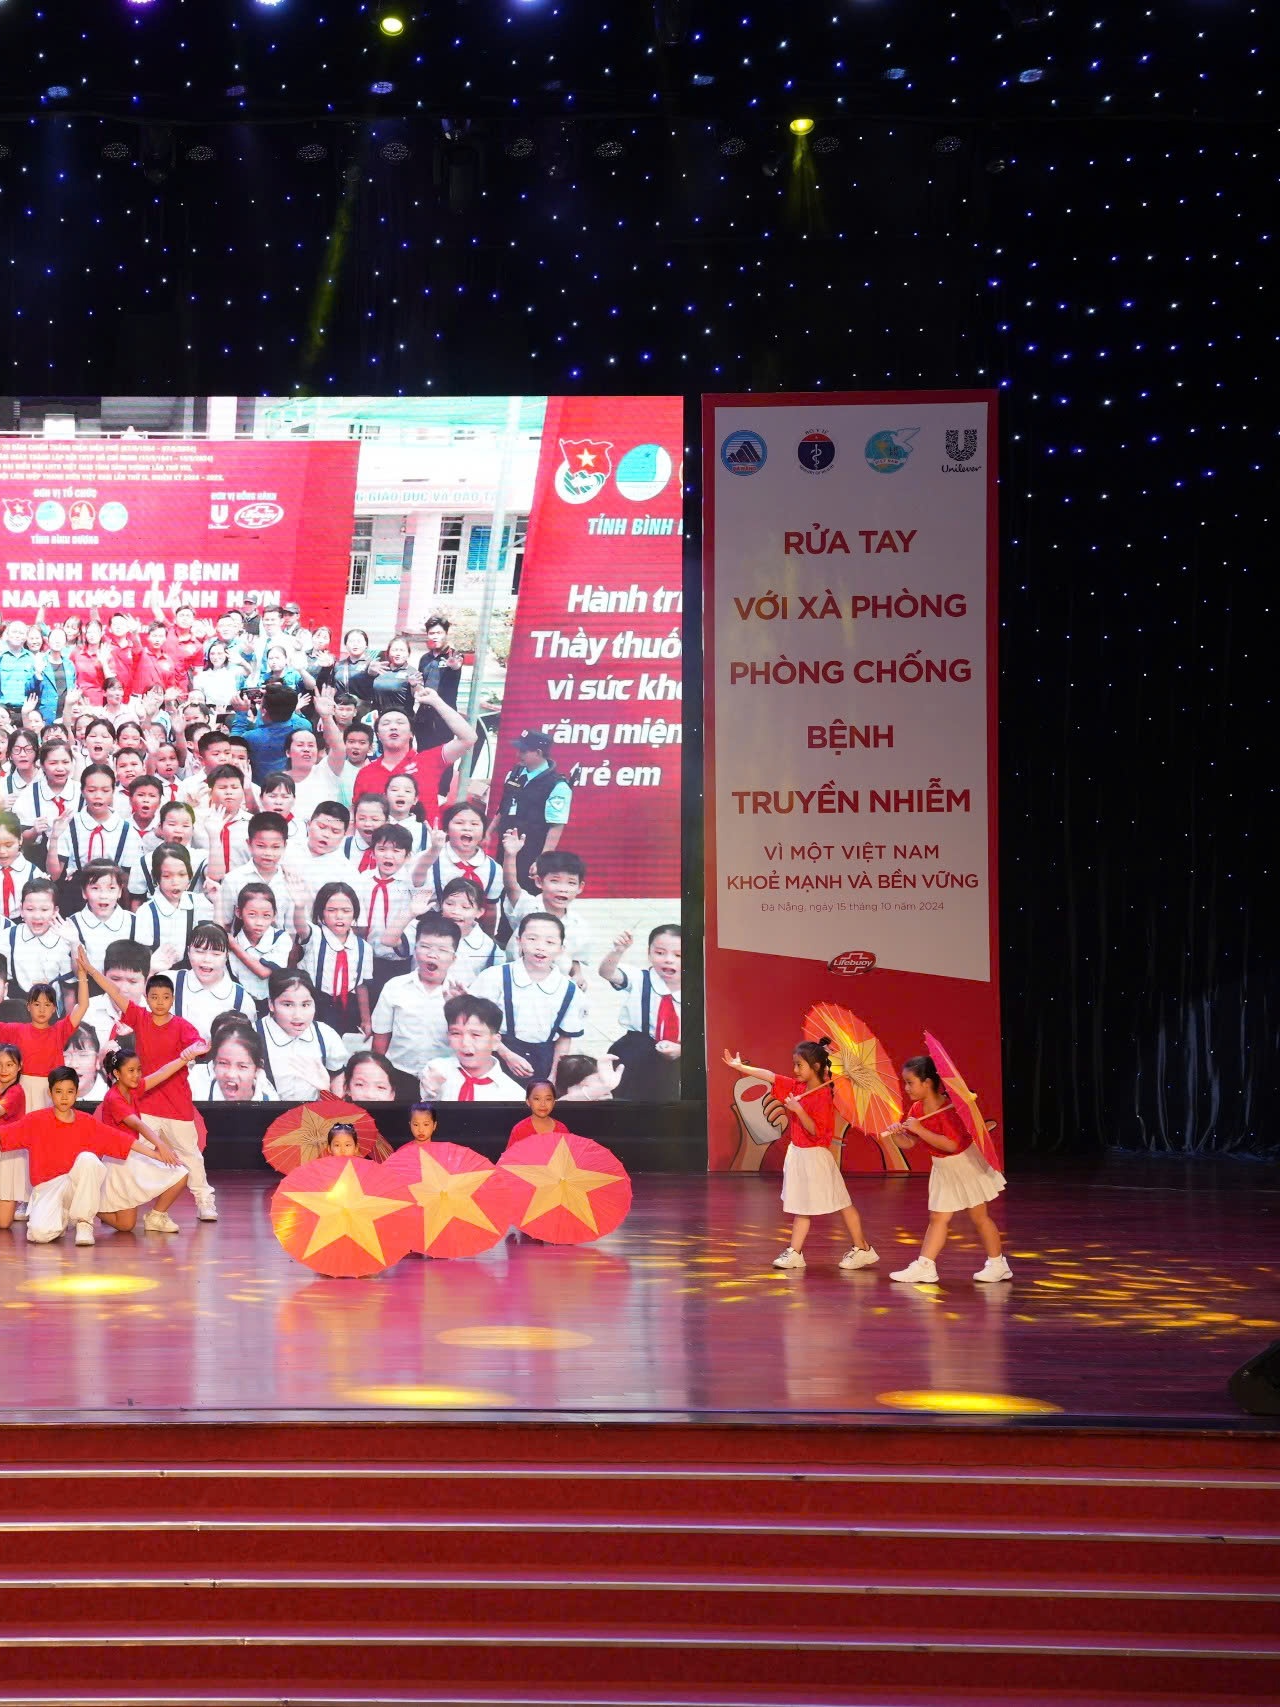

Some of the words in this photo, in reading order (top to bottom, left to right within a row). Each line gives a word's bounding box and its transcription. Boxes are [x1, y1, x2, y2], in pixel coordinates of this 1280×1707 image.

[941, 464, 982, 473] Unilever
[588, 513, 628, 536] TỈNH
[631, 514, 674, 536] BÌNH
[784, 523, 851, 555] RỬA
[859, 530, 918, 554] TAY
[6, 559, 83, 581] TRÌNH
[91, 559, 166, 581] KHÁM
[173, 559, 239, 586] BỆNH
[2, 589, 61, 609] NAM
[68, 585, 136, 609] KHỎE
[568, 584, 649, 613] Hành
[733, 590, 788, 621] VỚI
[798, 590, 842, 620] XÀ
[851, 588, 968, 619] PHÒNG
[531, 627, 609, 666] Thầy
[730, 654, 845, 685] PHÒNG
[853, 650, 972, 684] CHỐNG
[547, 674, 575, 701] vì
[578, 675, 634, 701] sức
[542, 719, 610, 751] răng
[807, 719, 894, 756] BỆNH
[616, 766, 661, 787] em
[732, 780, 860, 815] TRUYỀN
[870, 778, 971, 813] NHIỄM
[764, 843, 783, 861] VÌ
[791, 842, 835, 864] MỘT
[842, 842, 887, 863] VIỆT
[894, 845, 940, 860] NAM
[727, 870, 780, 890] KHOẺ
[786, 875, 842, 893] MẠNH
[848, 872, 873, 889] VÀ
[879, 869, 917, 889] BỀN
[922, 871, 979, 889] VỮNG
[809, 903, 834, 913] ngày
[837, 903, 847, 911] 15
[849, 903, 878, 912] tháng
[880, 903, 892, 911] 10
[895, 903, 916, 911] năm
[919, 902, 945, 911] 2024
[833, 959, 874, 968] Lifebuoy
